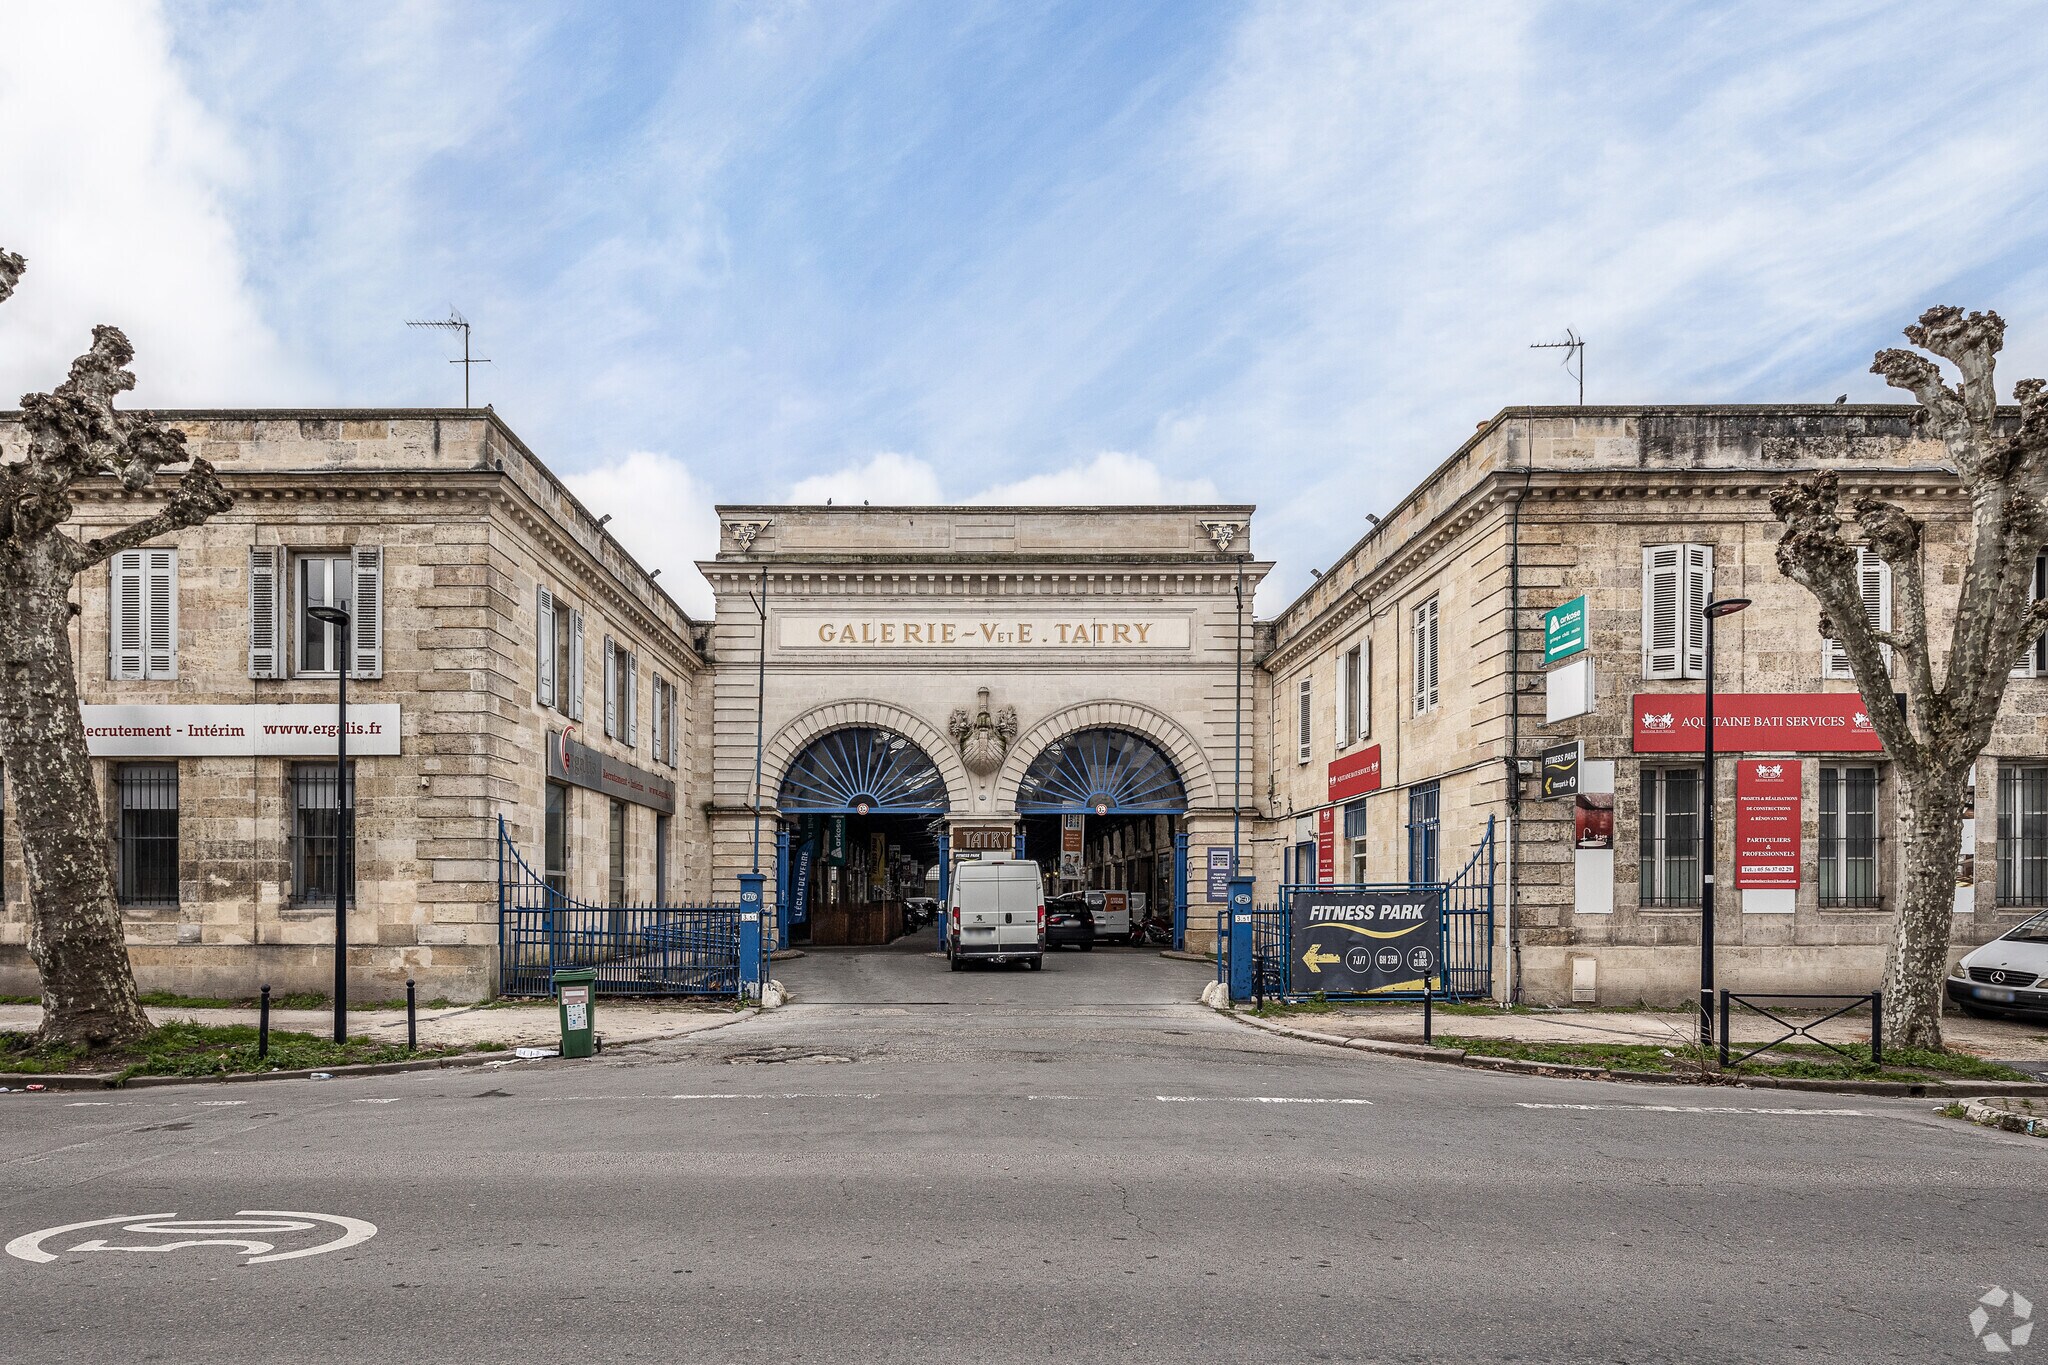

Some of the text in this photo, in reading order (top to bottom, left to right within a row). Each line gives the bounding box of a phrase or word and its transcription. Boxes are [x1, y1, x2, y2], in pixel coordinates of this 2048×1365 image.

[1560, 610, 1580, 624] arkose
[818, 622, 956, 644] GALERIE
[1054, 622, 1154, 644] TATRY
[1682, 716, 1845, 729] AQUTAINE BATI SERVICES
[188, 724, 246, 737] Intérim
[1545, 751, 1578, 766] FITNESS PARK
[963, 831, 1010, 848] TATRY
[800, 852, 808, 875] VERRE
[1309, 904, 1426, 920] FITNESS PARK
[1388, 955, 1397, 964] 23H
[1414, 959, 1427, 967] CLUBS
